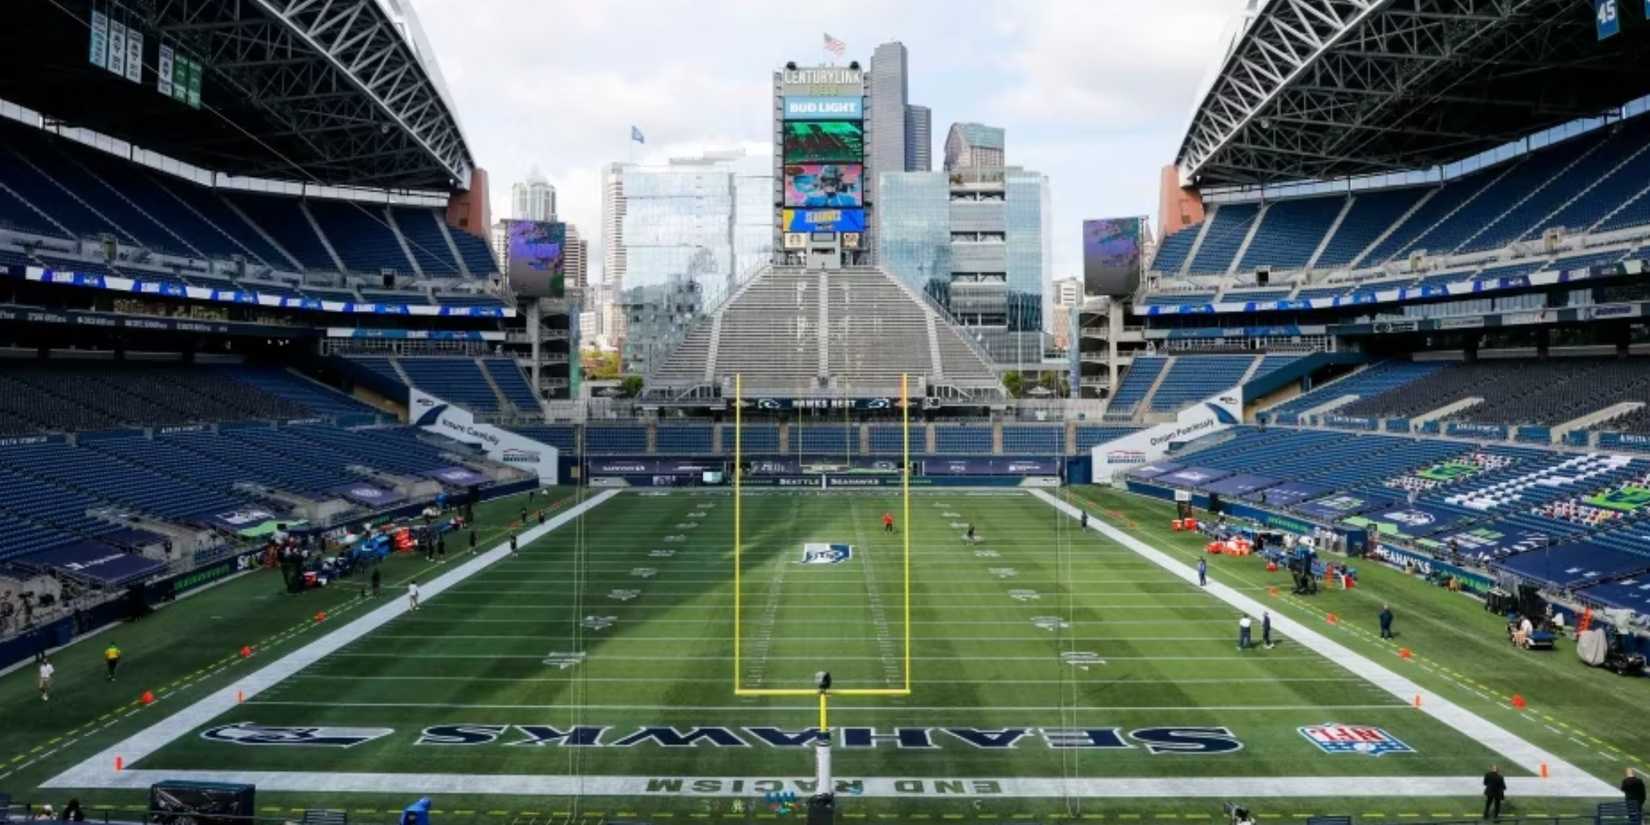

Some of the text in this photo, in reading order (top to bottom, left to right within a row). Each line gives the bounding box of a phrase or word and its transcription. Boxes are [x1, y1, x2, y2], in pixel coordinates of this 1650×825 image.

[1598, 0, 1616, 24] 45
[784, 70, 861, 84] CENTURYLINK
[790, 102, 856, 113] BUD LIGHT
[792, 399, 856, 408] HAWKS NEST
[414, 724, 1243, 754] SEAHAWKS
[645, 778, 1003, 794] END RACISM
